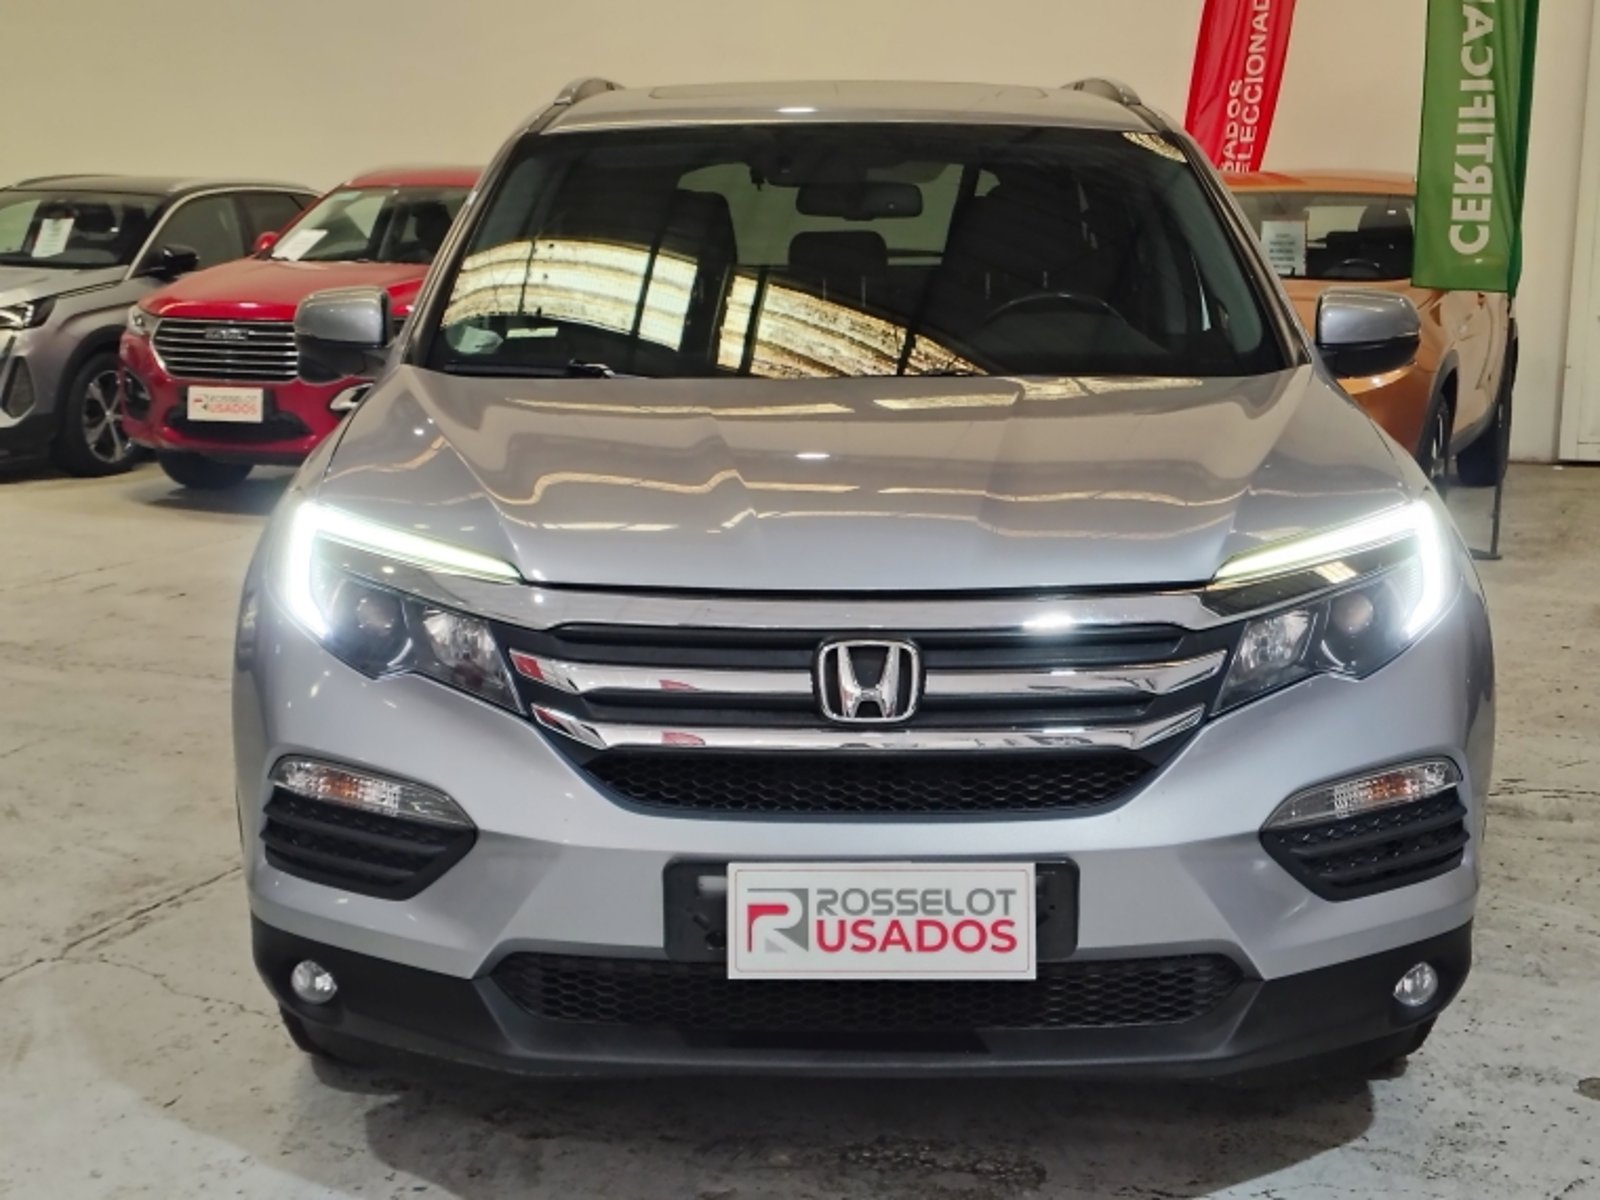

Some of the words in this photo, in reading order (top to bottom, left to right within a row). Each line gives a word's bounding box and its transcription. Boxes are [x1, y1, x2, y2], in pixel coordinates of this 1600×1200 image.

[1220, 79, 1243, 173] SADOS
[815, 887, 1018, 917] ROSSELOT
[815, 919, 1018, 954] USADOS
